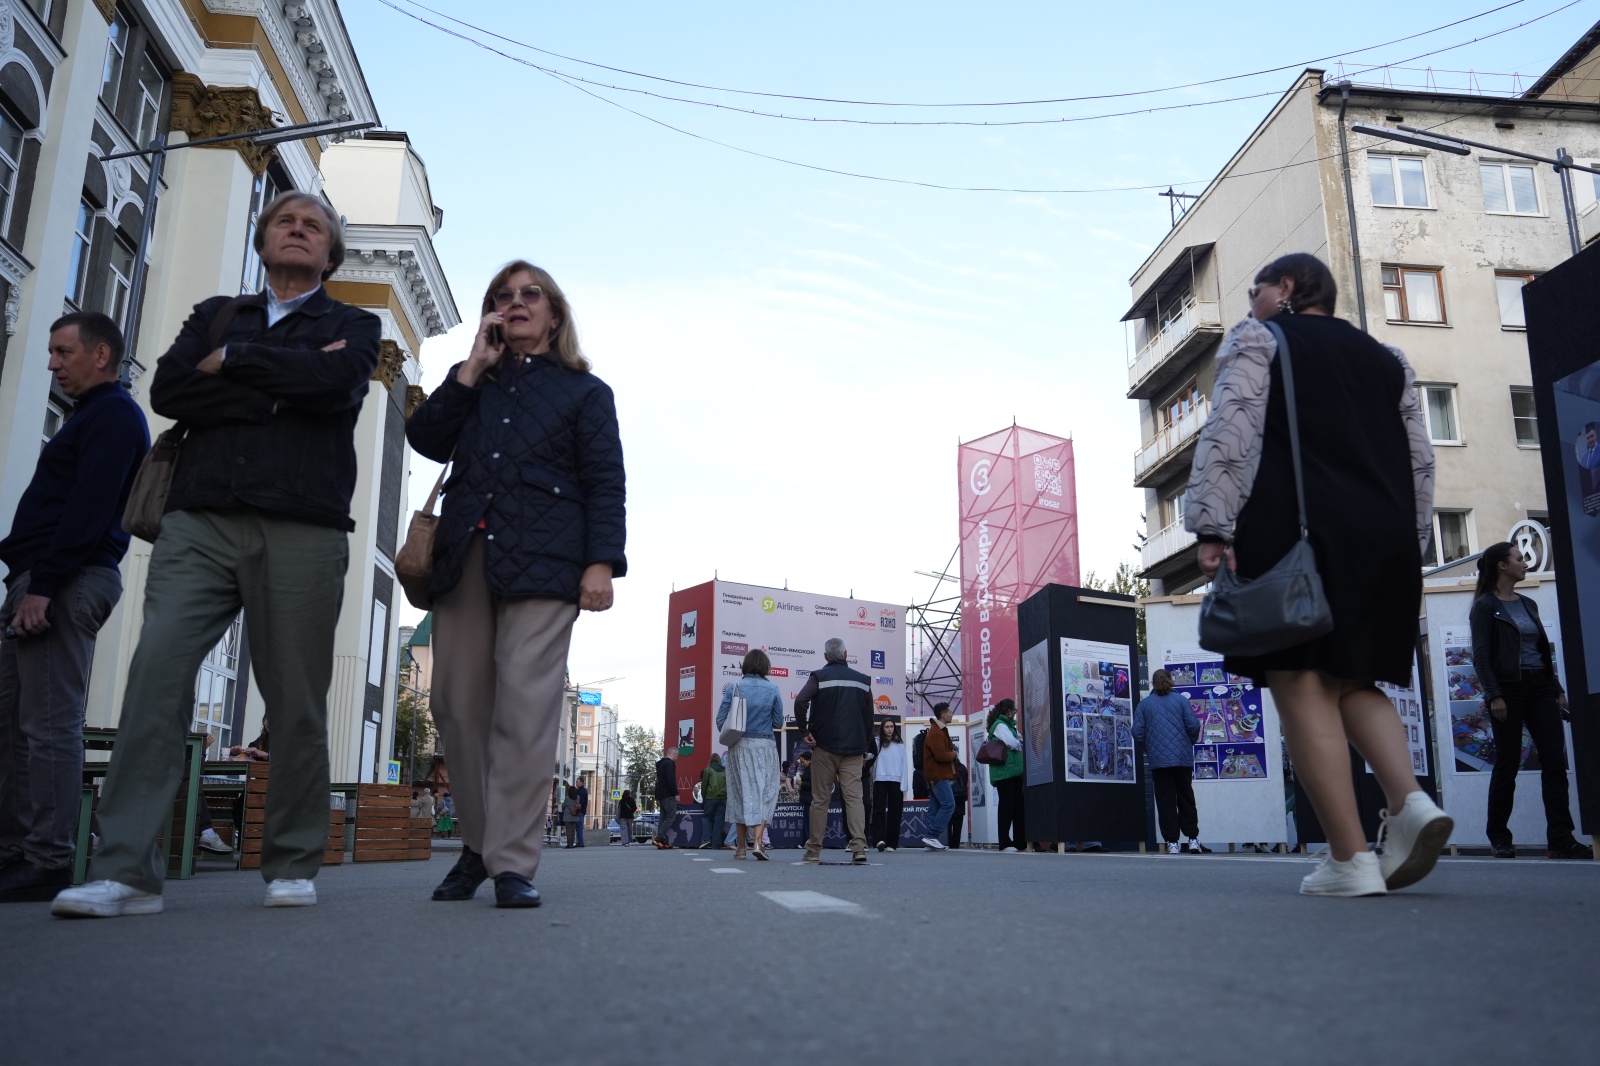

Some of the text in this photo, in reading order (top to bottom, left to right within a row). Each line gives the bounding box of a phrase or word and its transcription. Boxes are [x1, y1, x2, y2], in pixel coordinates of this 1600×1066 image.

[975, 520, 992, 604] Сибири
[722, 592, 754, 602] Генеральный
[763, 600, 804, 612] S7 Airlines
[721, 630, 747, 638] Партнёры
[768, 646, 816, 655] НОВО-ЯМСКОЙ
